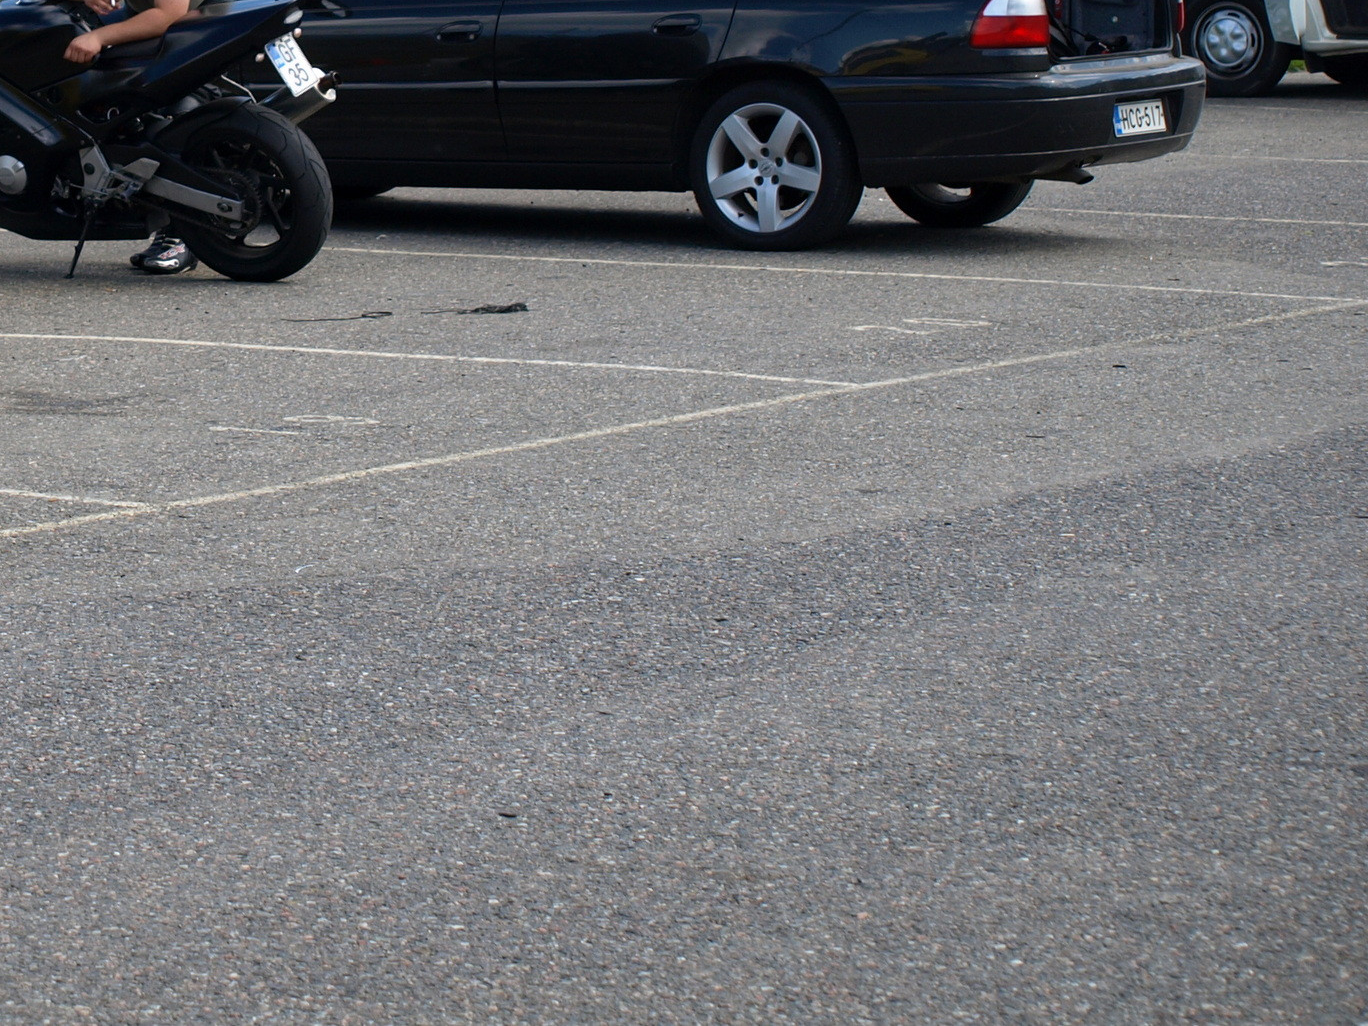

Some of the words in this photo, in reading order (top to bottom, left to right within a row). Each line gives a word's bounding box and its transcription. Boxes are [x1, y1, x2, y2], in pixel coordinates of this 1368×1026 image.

[277, 39, 296, 63] GF
[288, 63, 309, 87] 35
[1120, 105, 1161, 131] HCG-517
